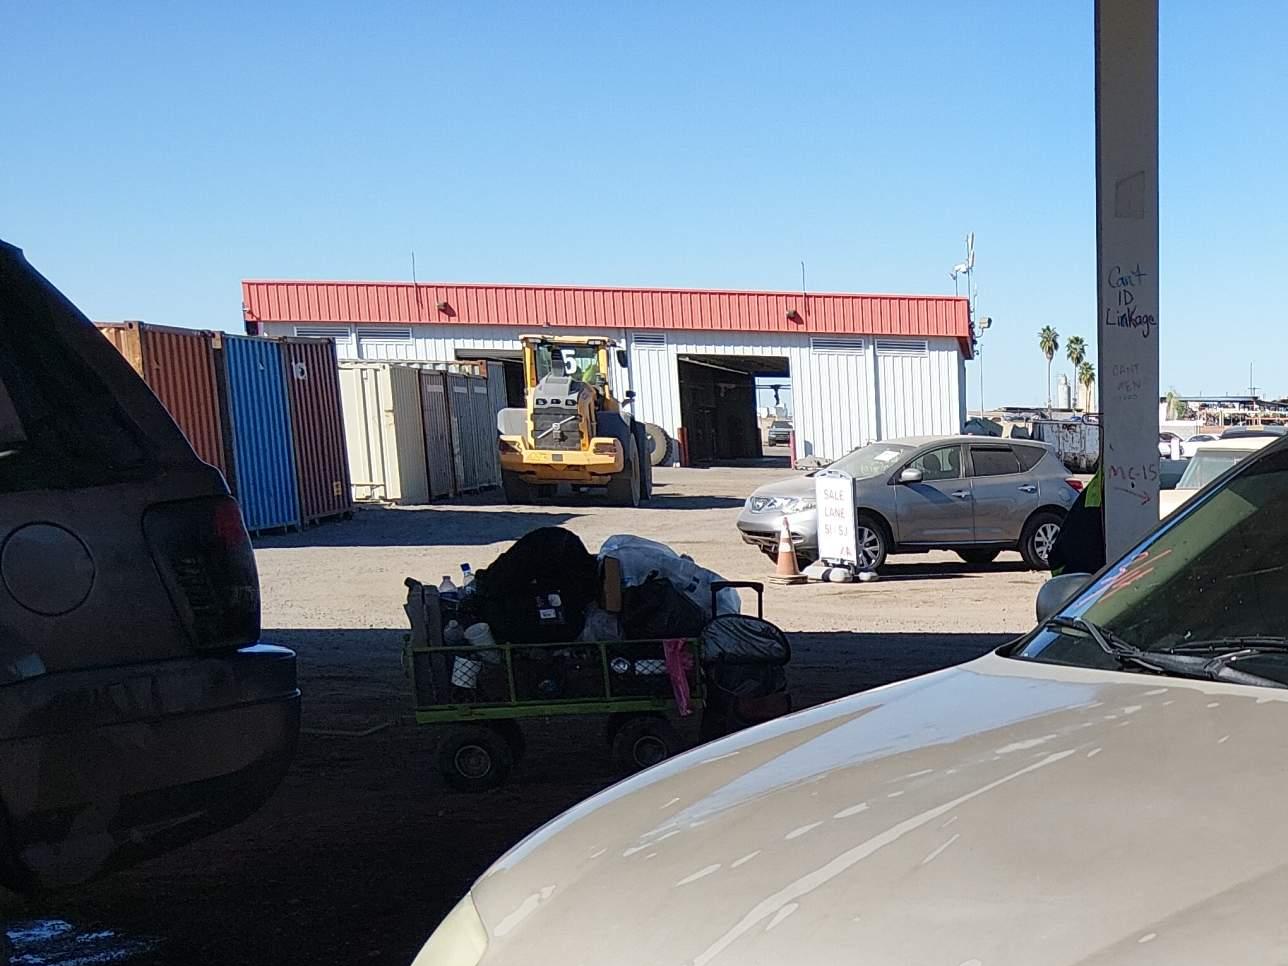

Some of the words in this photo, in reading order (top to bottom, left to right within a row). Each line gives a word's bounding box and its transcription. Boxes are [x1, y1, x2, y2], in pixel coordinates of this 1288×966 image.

[1117, 289, 1135, 306] ID
[561, 349, 577, 375] 5
[1108, 464, 1158, 481] MC-15
[823, 488, 845, 501] SALE
[824, 505, 846, 519] LANE
